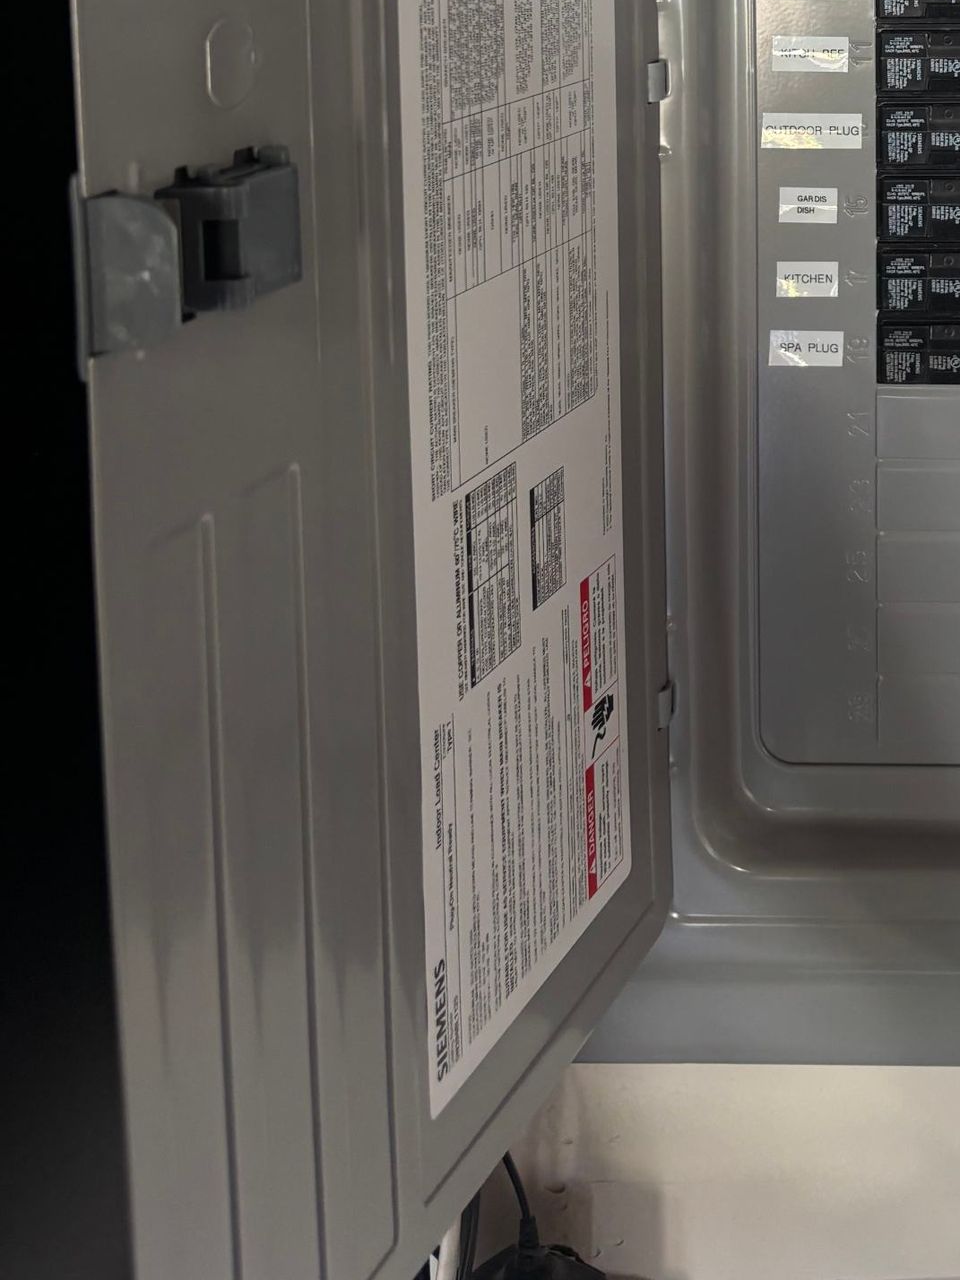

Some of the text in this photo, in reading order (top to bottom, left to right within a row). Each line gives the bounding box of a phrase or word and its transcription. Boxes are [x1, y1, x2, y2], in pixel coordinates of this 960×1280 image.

[766, 125, 822, 135] OUTDOOR
[829, 125, 859, 136] PLUG
[784, 274, 833, 283] KITCHEN
[780, 342, 838, 353] SPA PLUG
[587, 790, 595, 855] DANGER
[434, 959, 448, 1080] SIEMENS
